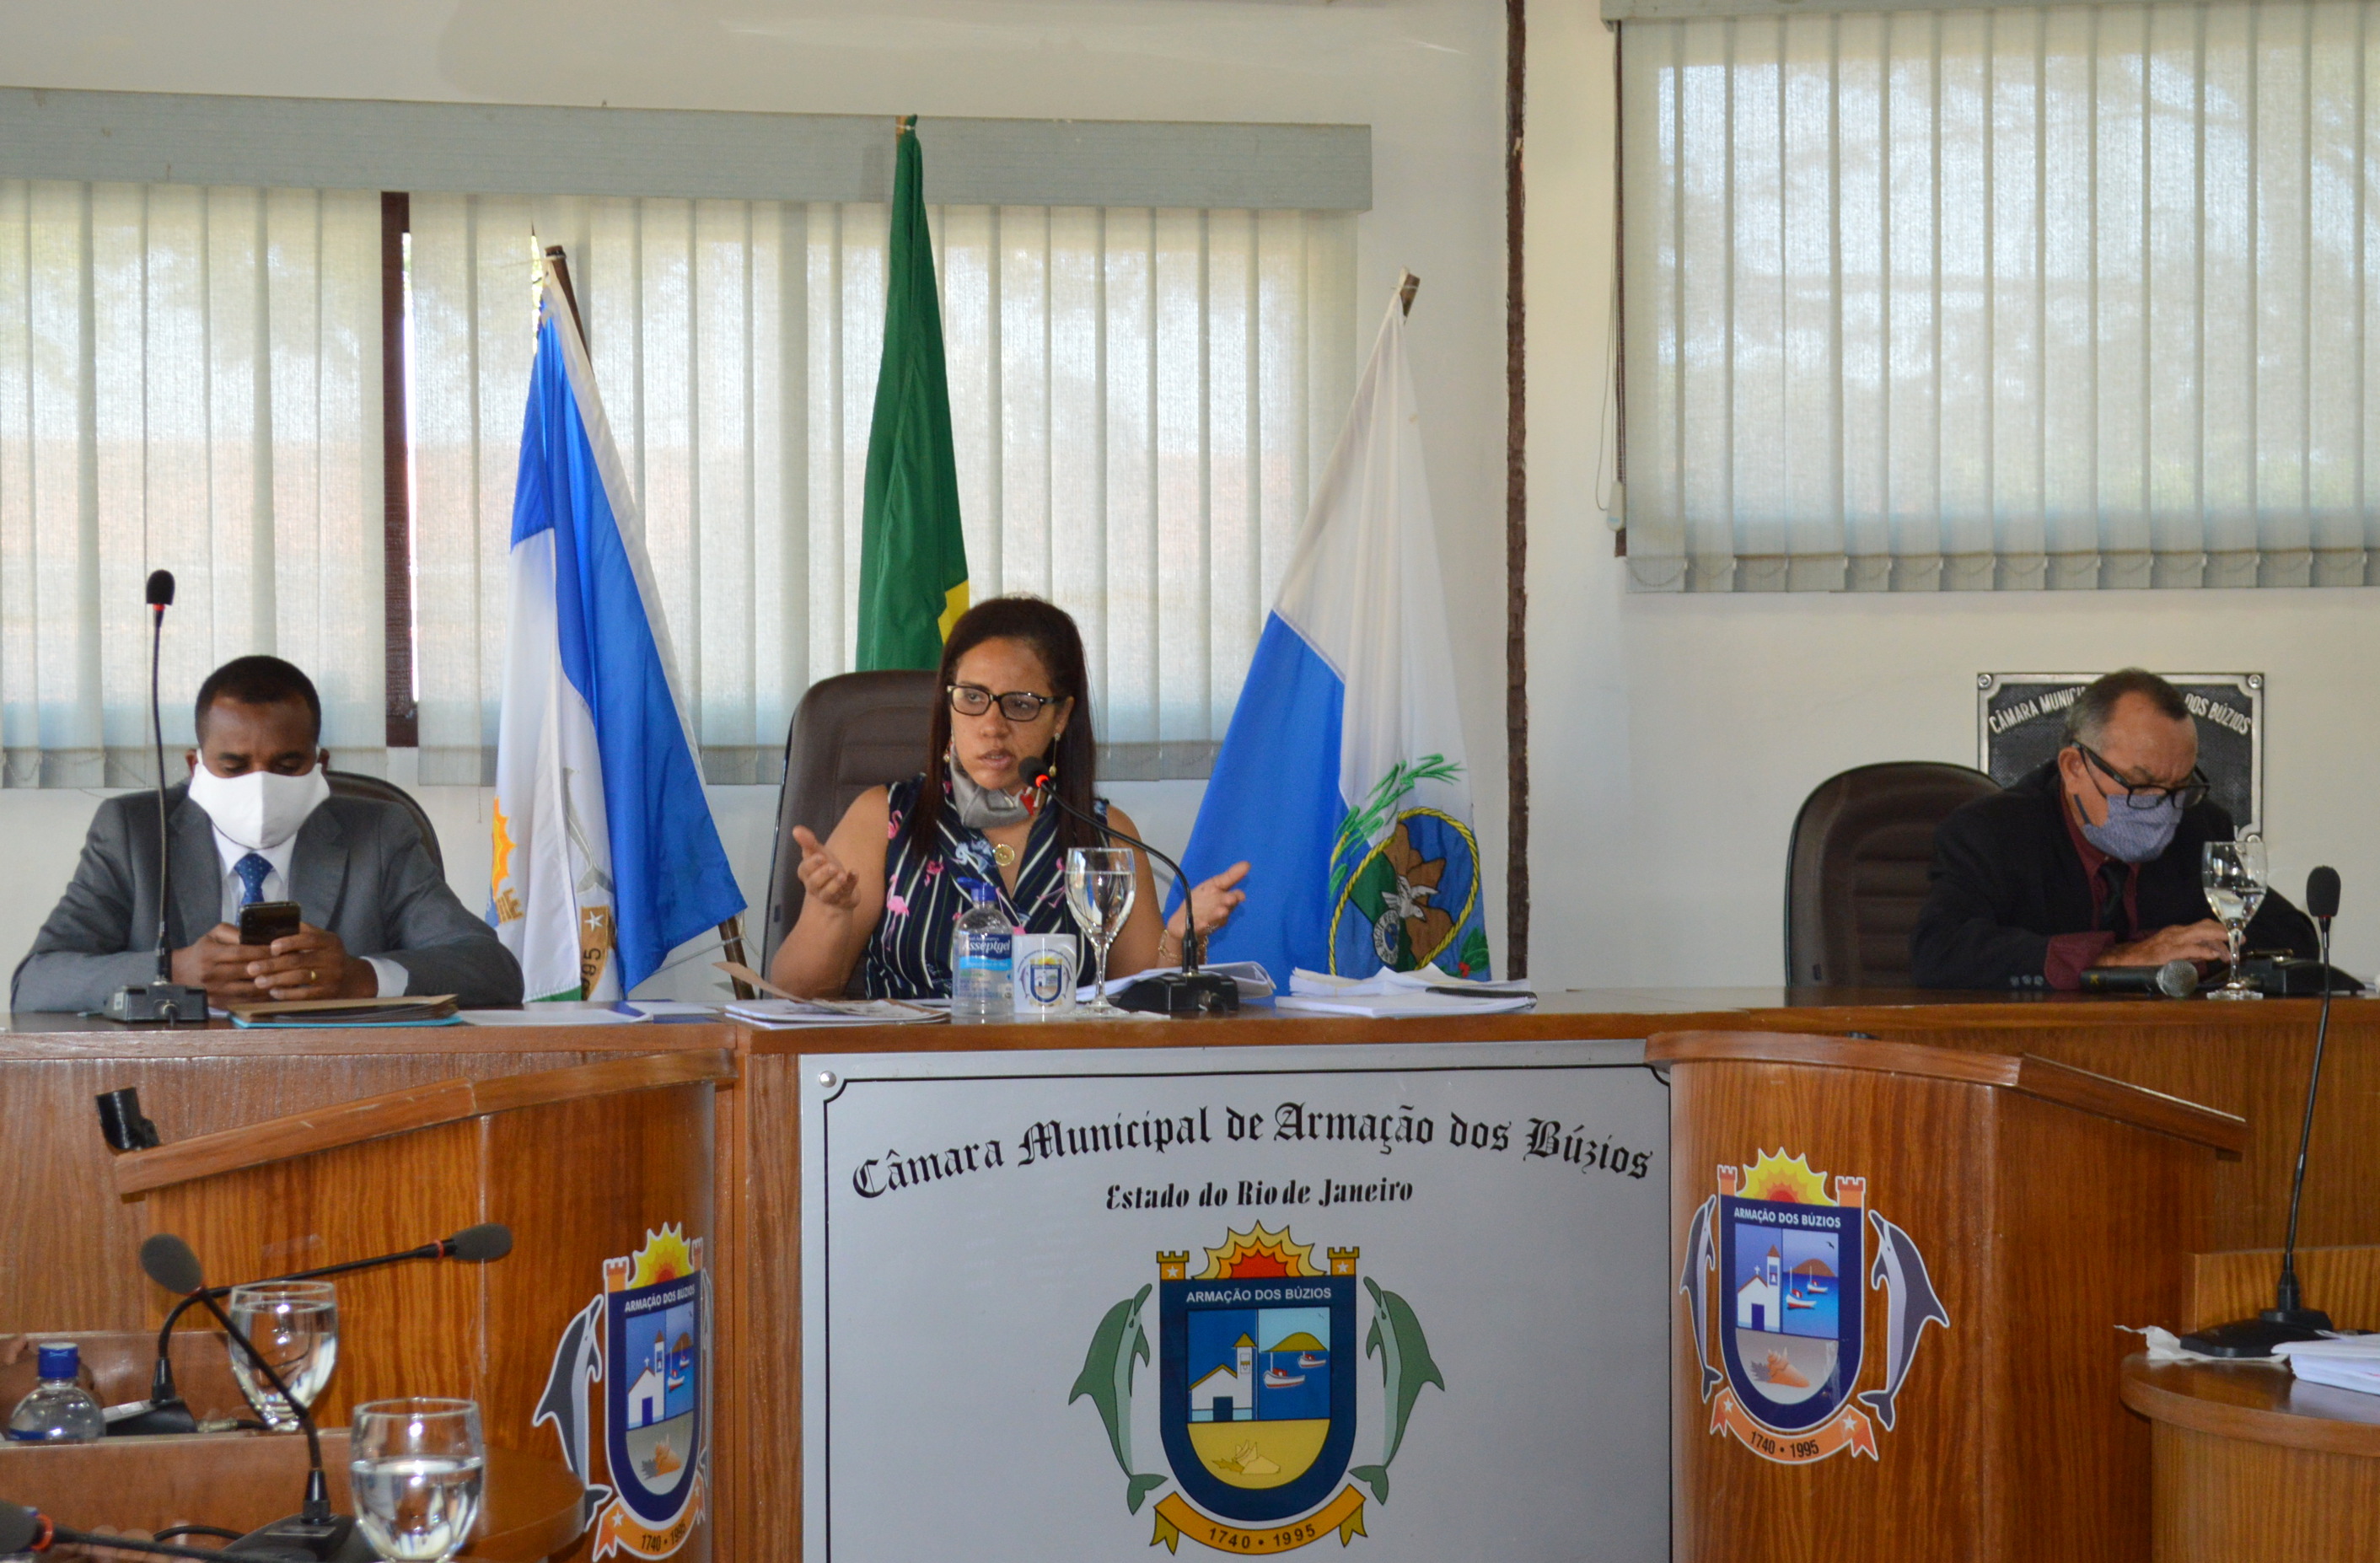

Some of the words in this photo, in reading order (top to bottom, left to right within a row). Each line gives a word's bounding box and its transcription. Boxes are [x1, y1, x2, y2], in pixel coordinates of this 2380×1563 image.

[1989, 699, 2040, 734] CÂMARA
[2184, 692, 2210, 717] DOS
[2207, 701, 2252, 735] BÚZIOS
[852, 1140, 1004, 1199] Câmara
[1018, 1106, 1211, 1167] Municipal
[1226, 1106, 1264, 1141] de
[1273, 1102, 1434, 1155] Armação
[1449, 1112, 1509, 1152] dos
[1525, 1117, 1653, 1180] Búzios
[1106, 1183, 1190, 1210] Estado
[1199, 1182, 1228, 1207] do
[1238, 1180, 1278, 1206] Rio
[1281, 1179, 1311, 1205] de
[1318, 1177, 1413, 1207] Janeiro
[1733, 1206, 1776, 1223] ARMAÇÃO
[1778, 1211, 1799, 1225] DOS
[1801, 1211, 1841, 1228] BÚZIOS
[625, 1292, 662, 1313] ARMAÇÃO
[663, 1290, 676, 1304] DOS
[677, 1283, 696, 1300] BÚZIOS
[1186, 1288, 1252, 1304] ARMAÇÃO
[1255, 1290, 1281, 1300] DOS
[1285, 1286, 1332, 1299] BÚZIOS
[1750, 1431, 1776, 1455] 1740
[1790, 1439, 1819, 1458] 1995
[641, 1534, 662, 1552] 1740
[1209, 1527, 1251, 1550] 1740
[1273, 1523, 1316, 1547] 1995
